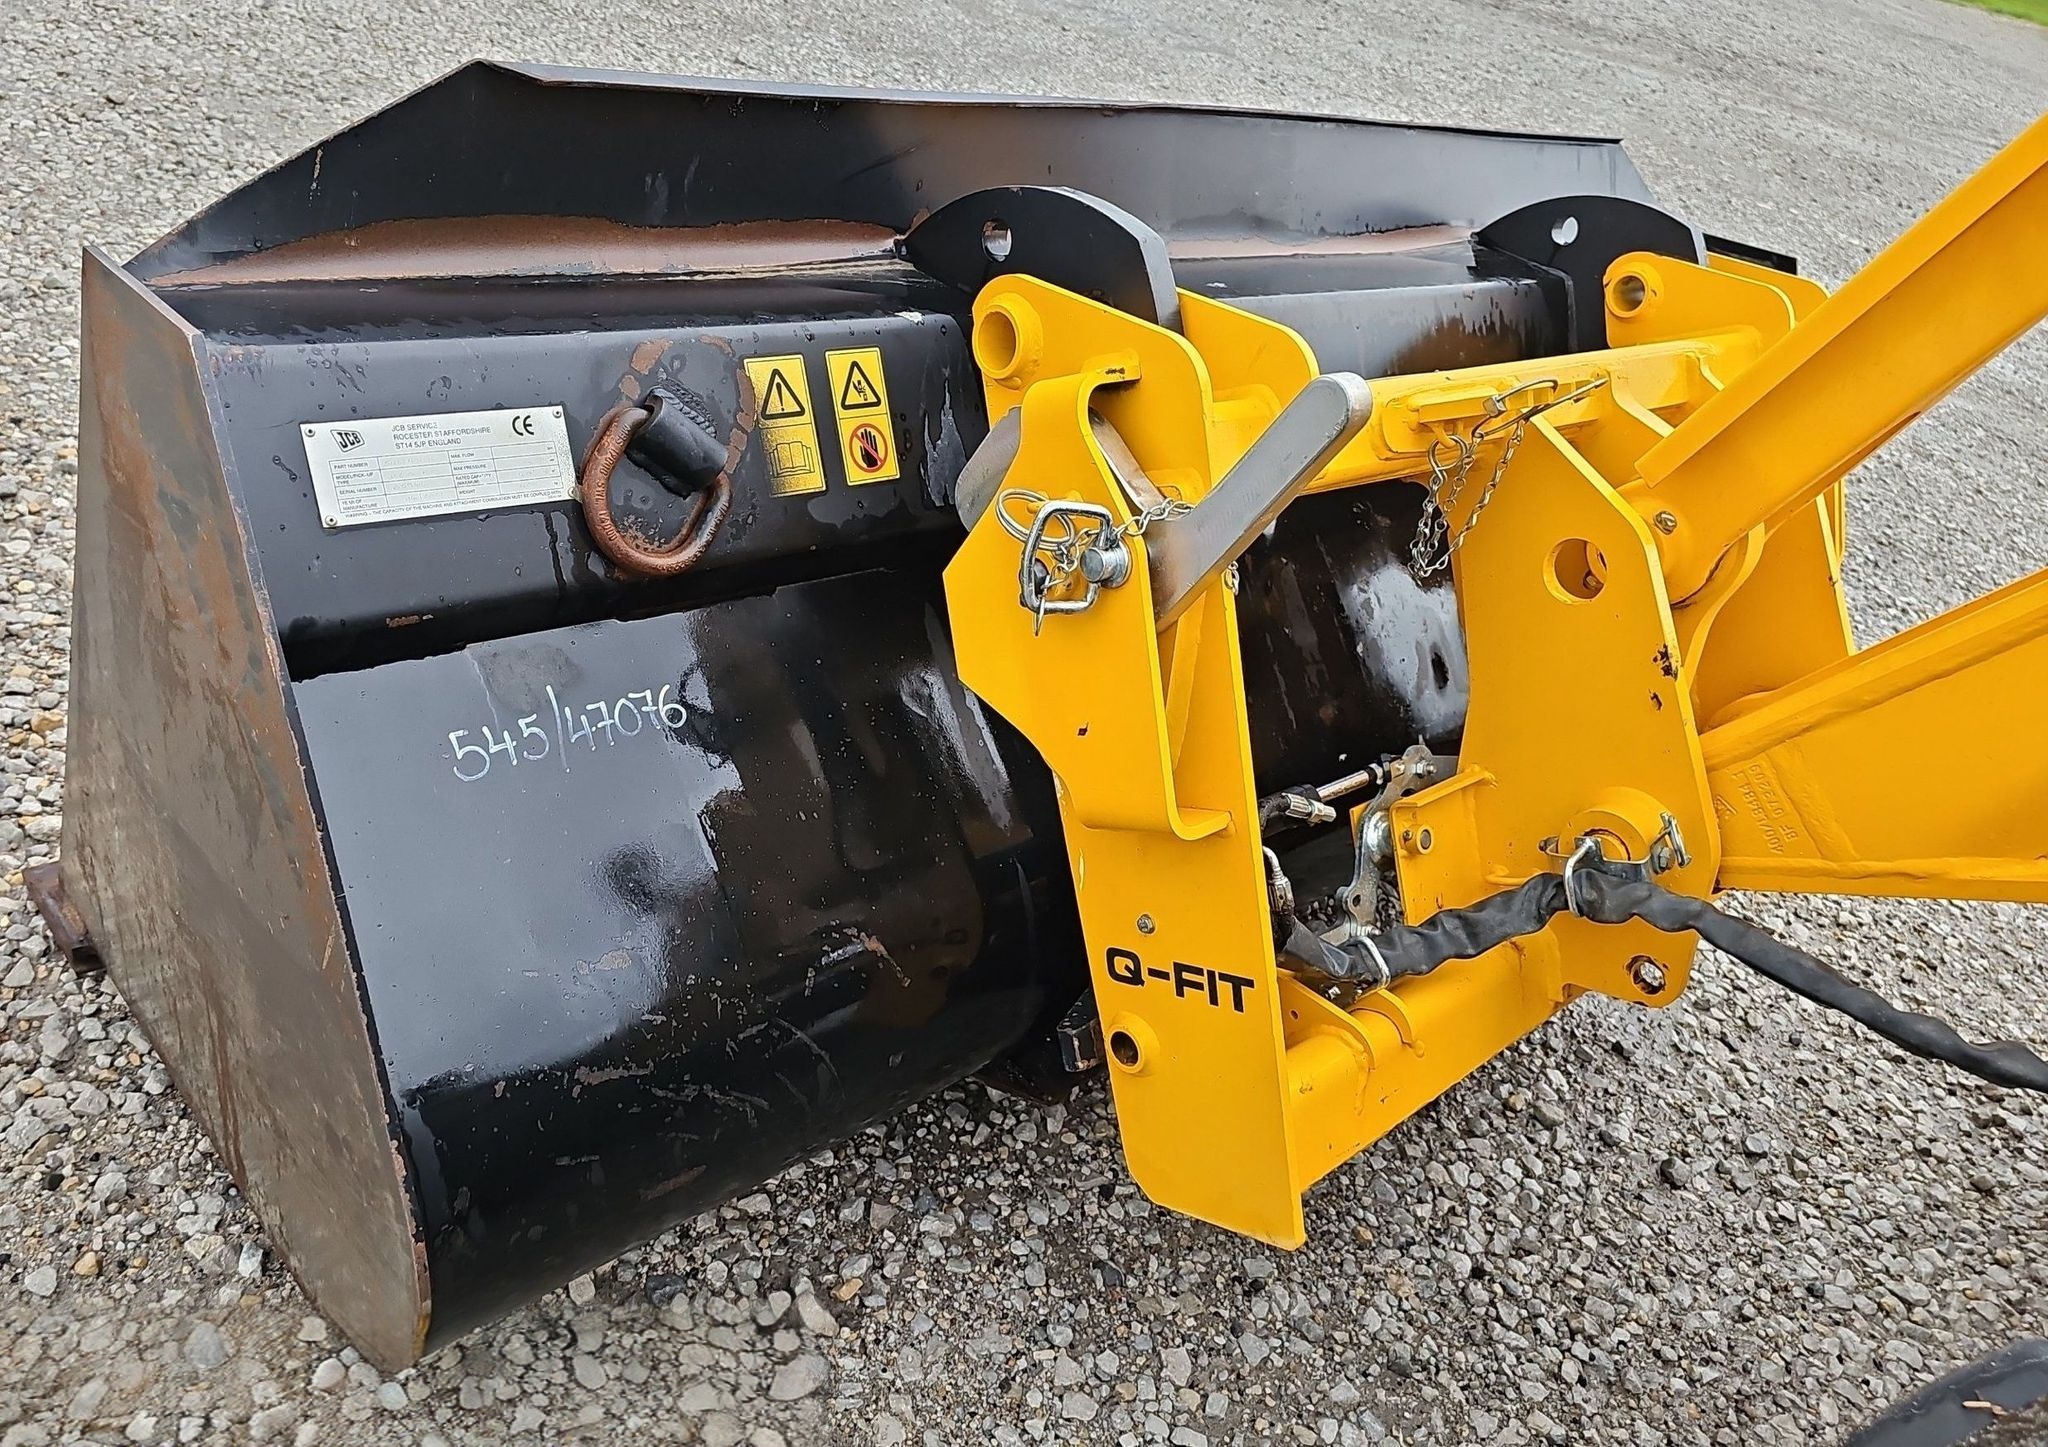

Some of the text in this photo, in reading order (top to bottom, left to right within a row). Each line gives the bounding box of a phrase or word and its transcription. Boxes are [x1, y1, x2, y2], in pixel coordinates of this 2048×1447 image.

[433, 426, 491, 437] STAFFORDSHIRE
[510, 415, 534, 436] CE
[337, 431, 362, 448] JCB
[394, 441, 415, 449] ST14
[427, 437, 461, 446] ENGLAND
[448, 684, 687, 781] 545/47076
[1106, 947, 1255, 1013] Q-FIT
